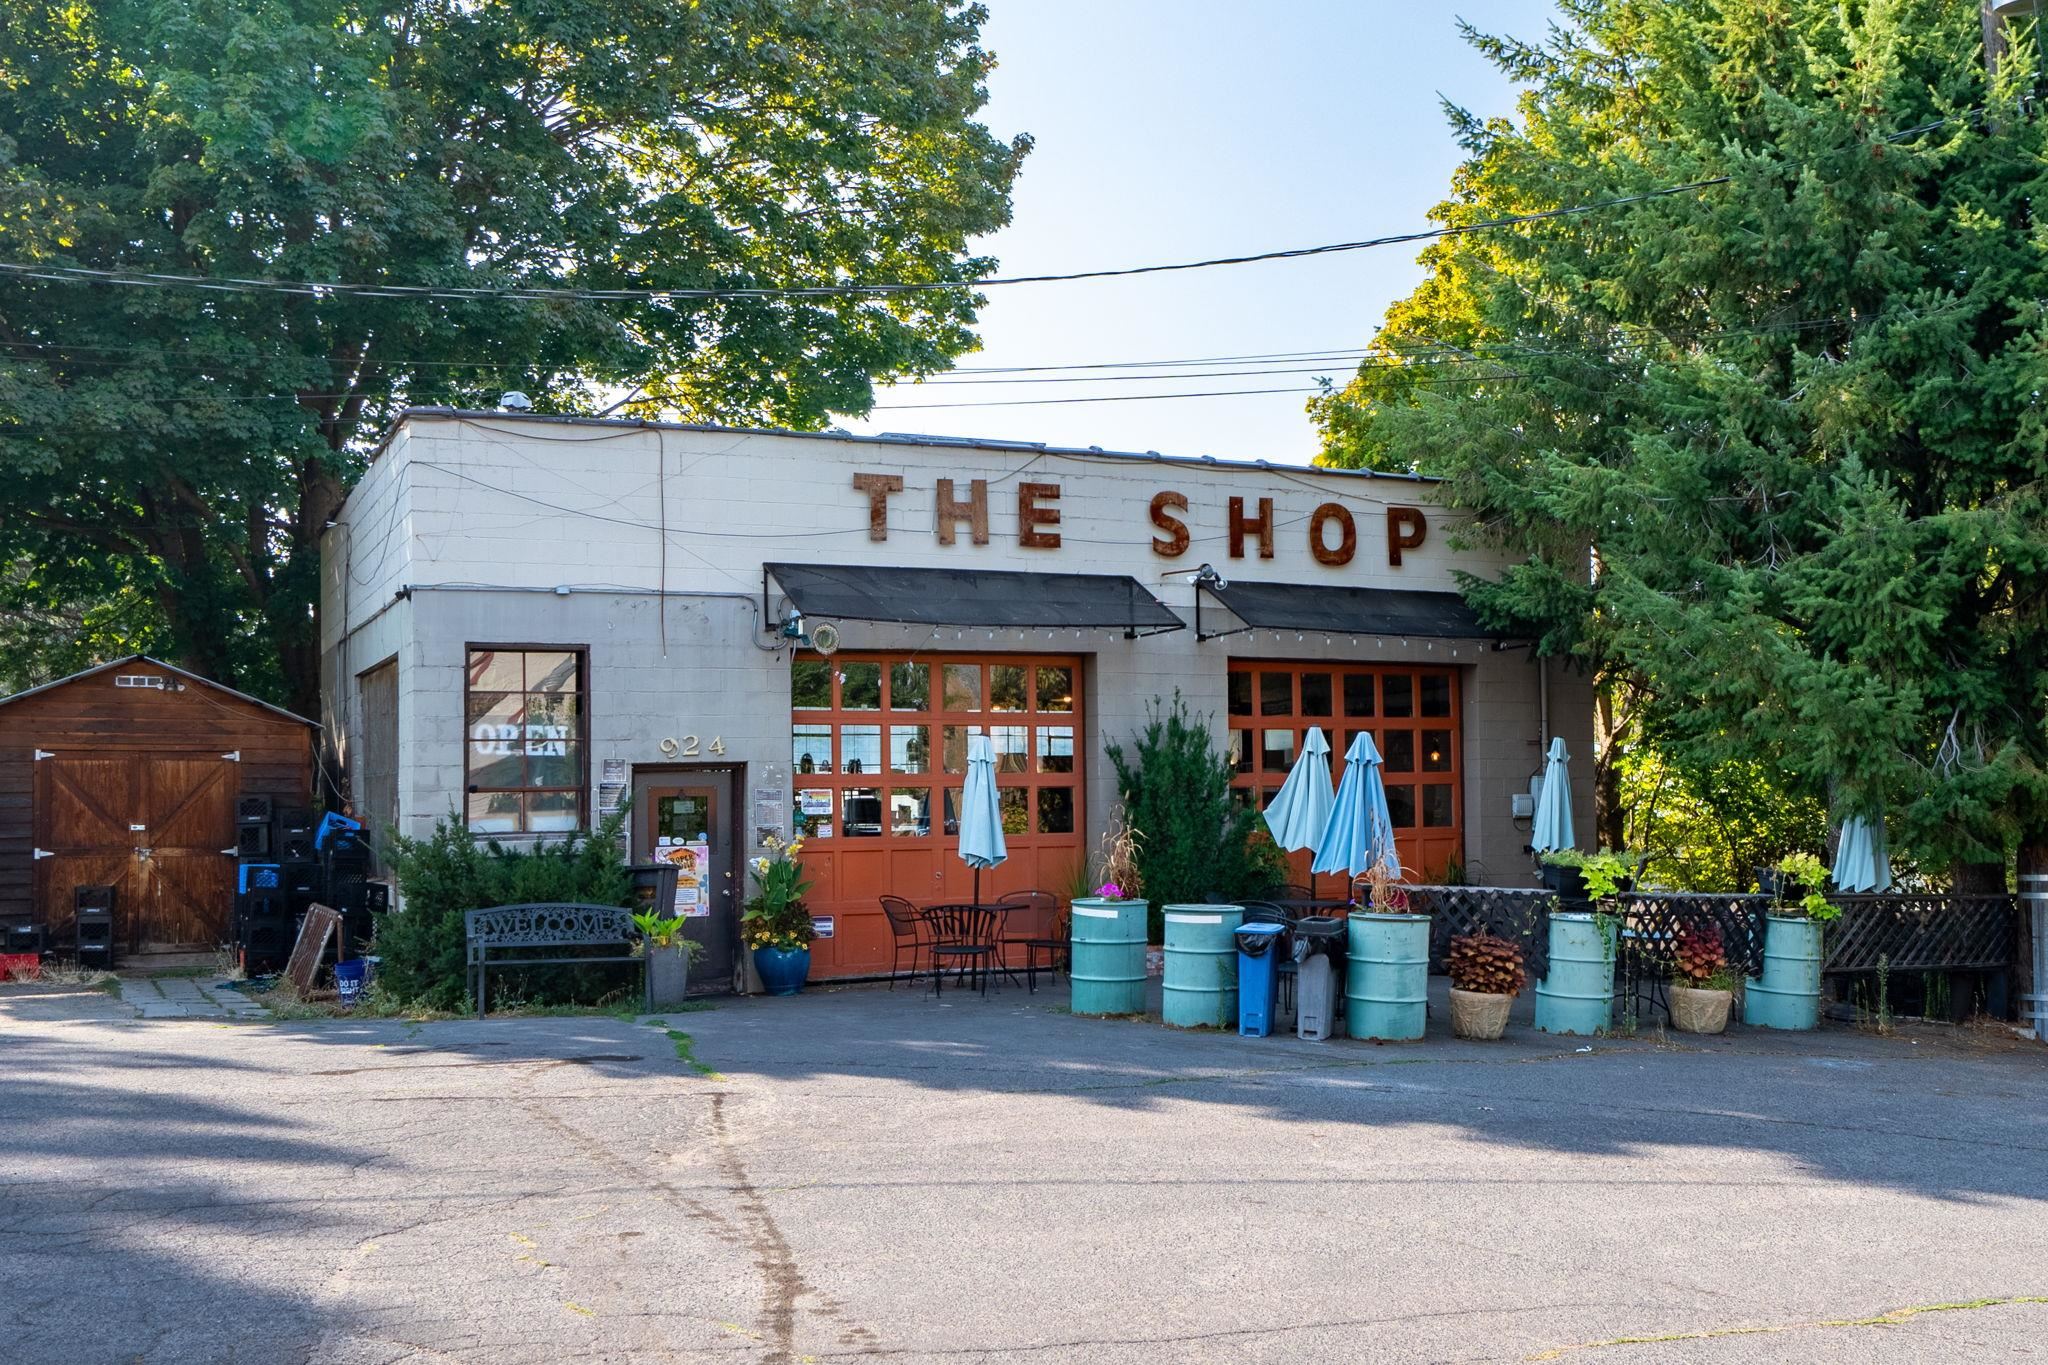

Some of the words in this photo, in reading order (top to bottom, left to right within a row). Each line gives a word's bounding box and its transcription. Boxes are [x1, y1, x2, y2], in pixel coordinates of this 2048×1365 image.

[853, 472, 1061, 549] THE
[1150, 491, 1427, 567] SHOP
[475, 723, 568, 756] OPEN
[660, 735, 725, 758] 924
[490, 915, 614, 935] WELCOME
